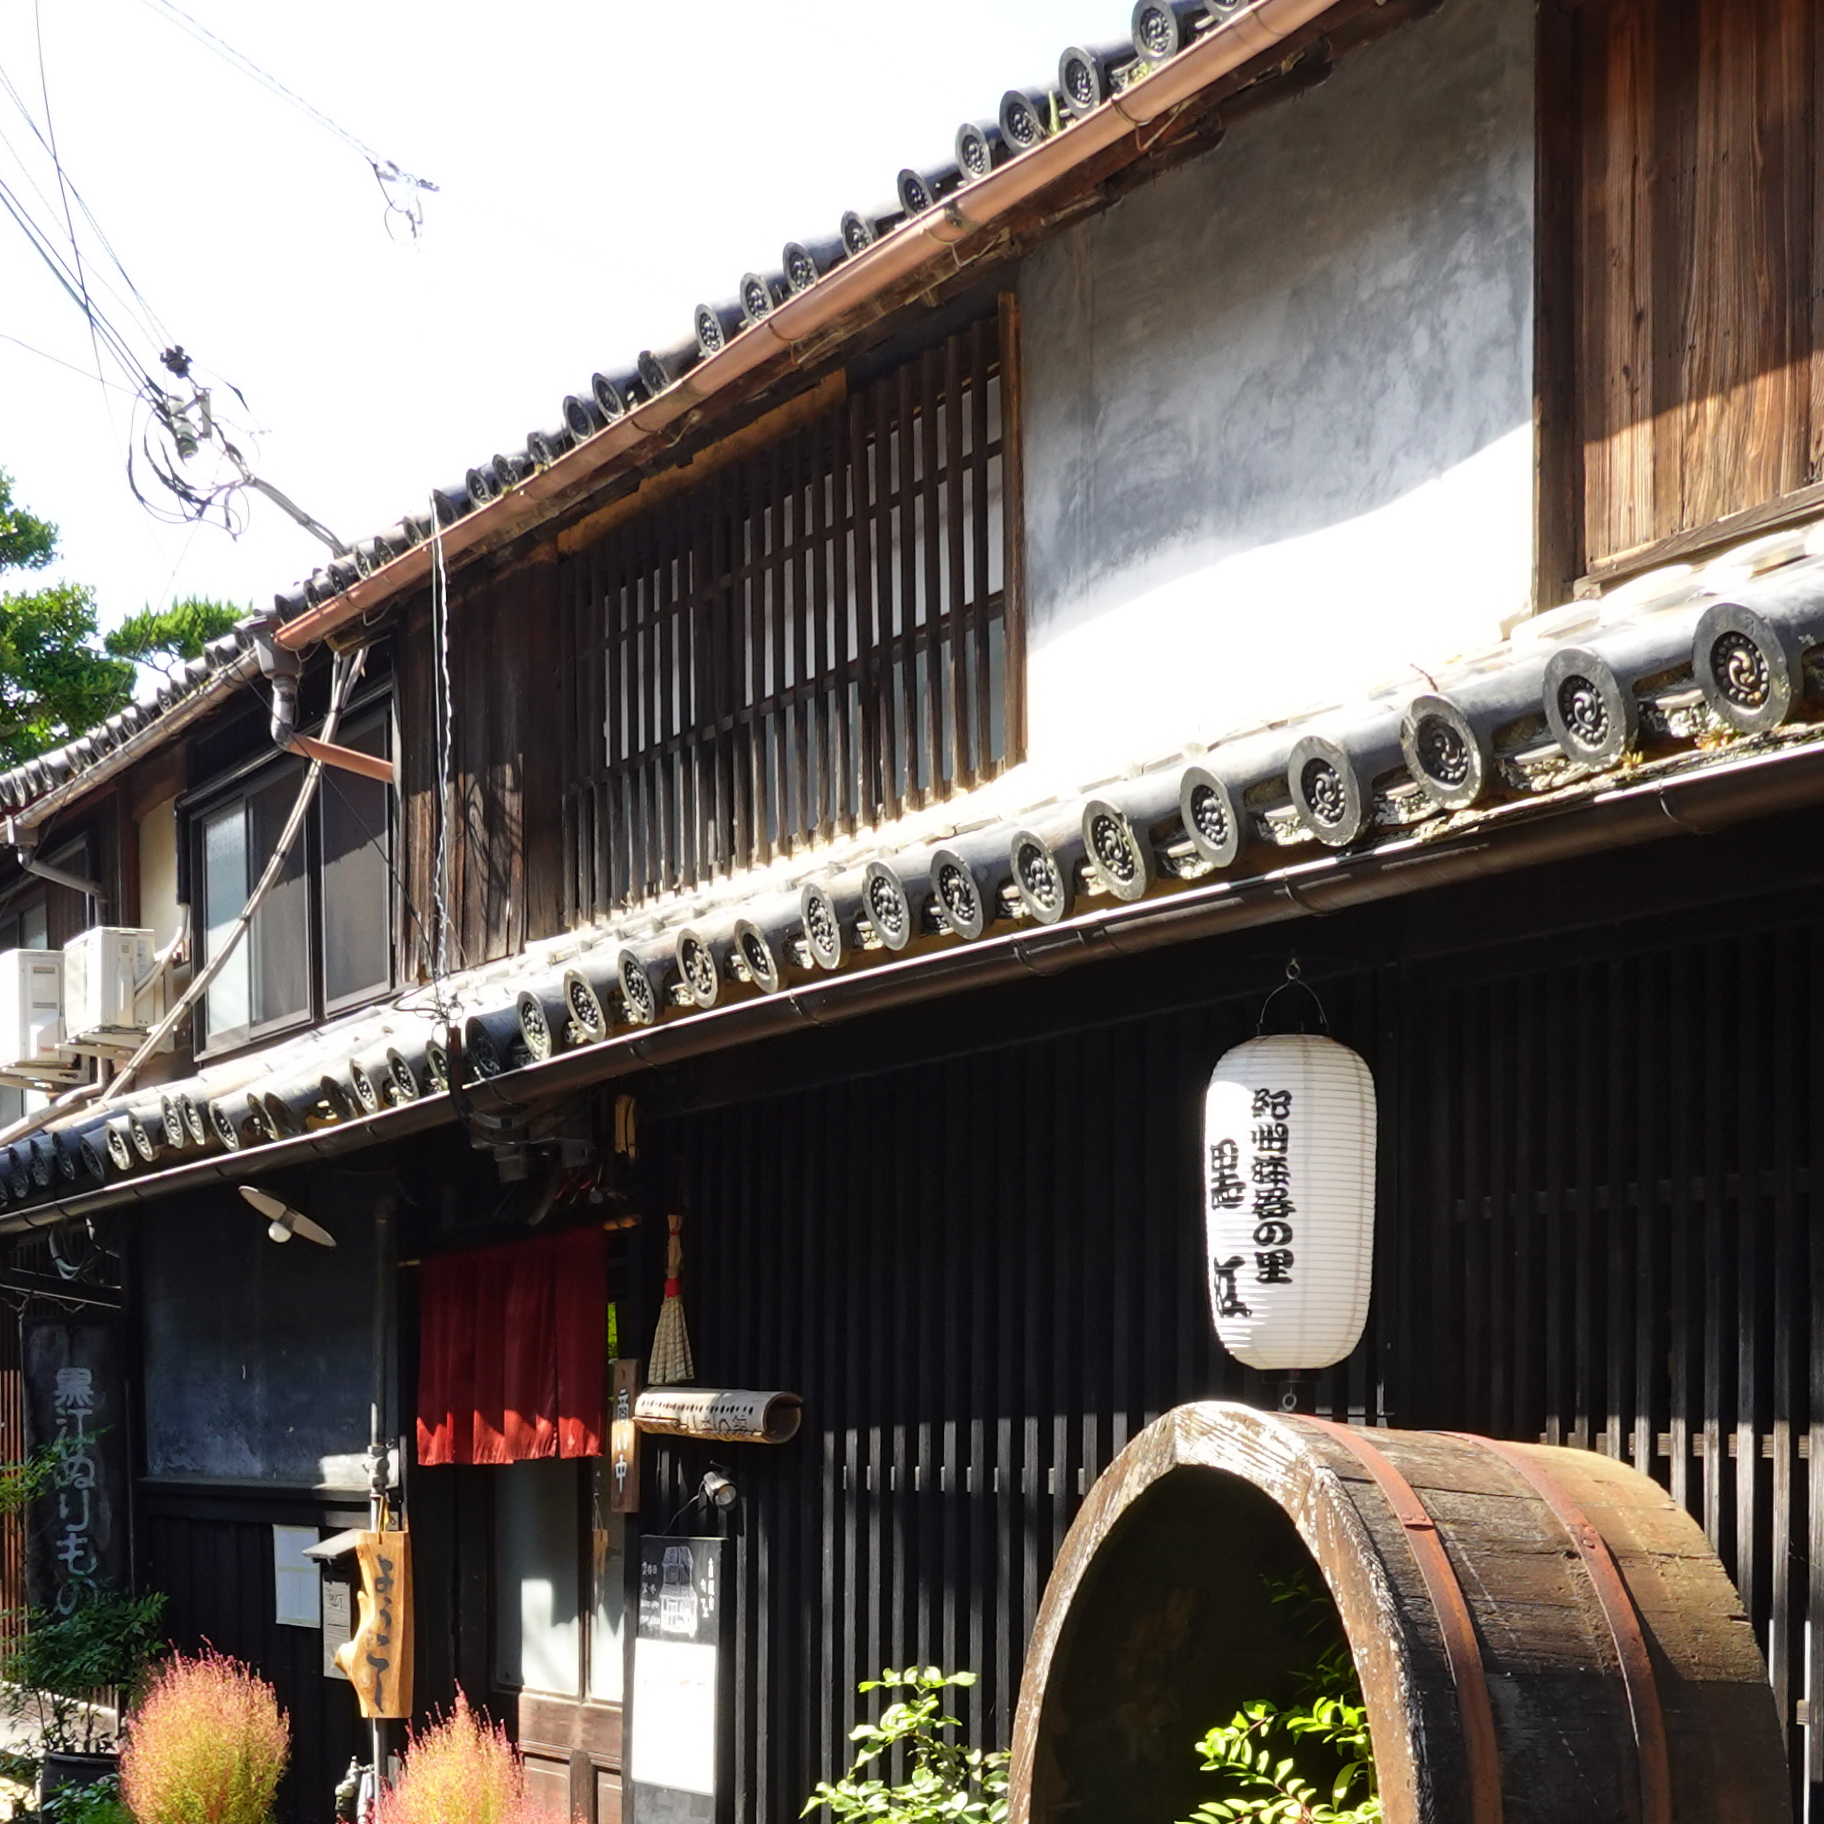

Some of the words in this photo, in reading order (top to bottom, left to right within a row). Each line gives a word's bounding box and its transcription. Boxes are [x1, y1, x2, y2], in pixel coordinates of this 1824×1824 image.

[53, 1367, 98, 1615] 黒江ぬりもの
[615, 1387, 631, 1495] 商い中
